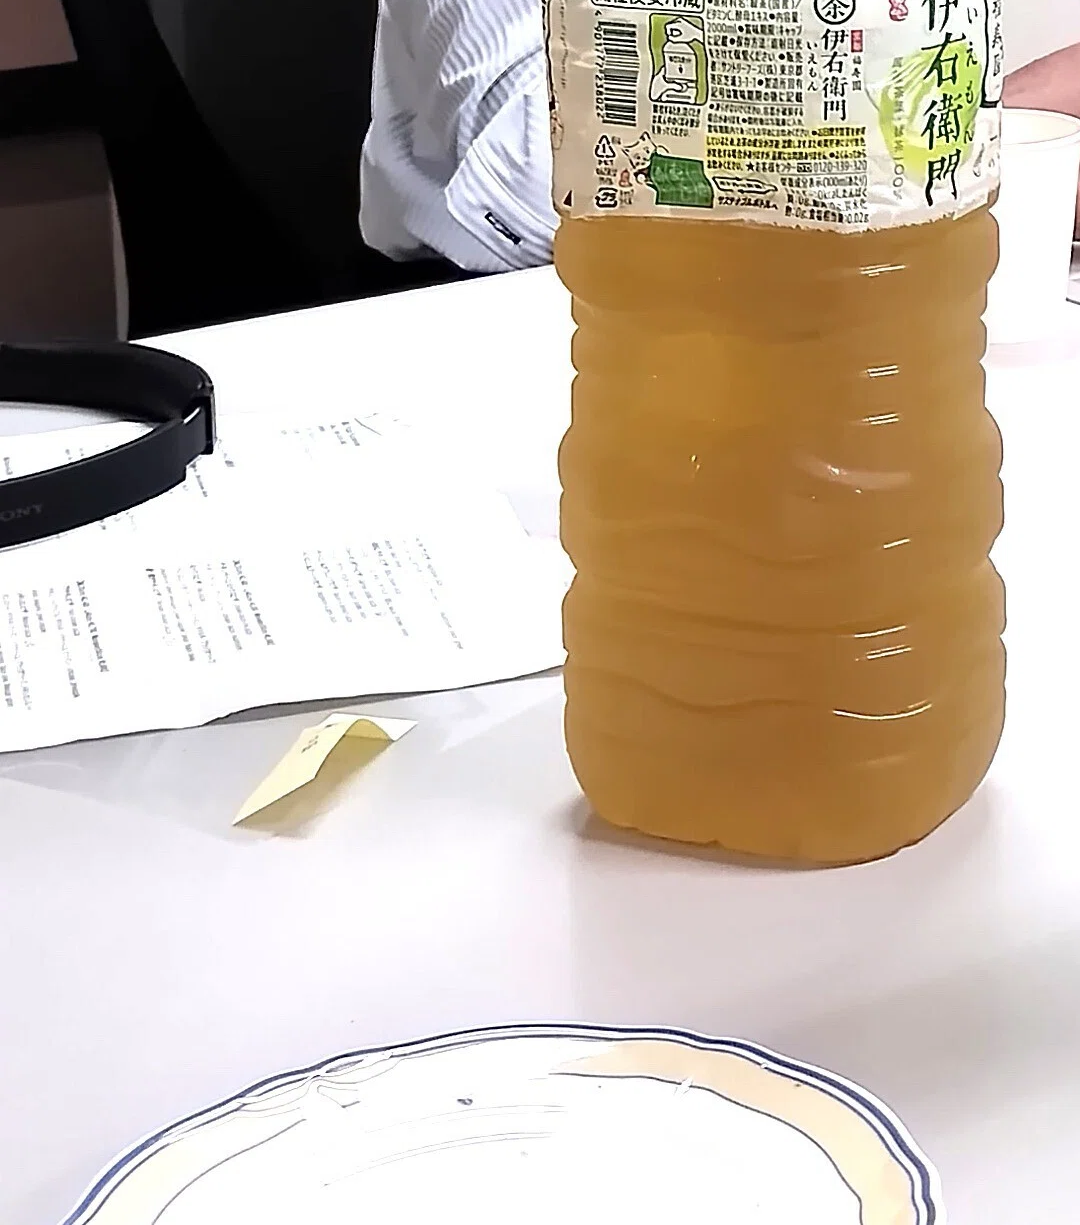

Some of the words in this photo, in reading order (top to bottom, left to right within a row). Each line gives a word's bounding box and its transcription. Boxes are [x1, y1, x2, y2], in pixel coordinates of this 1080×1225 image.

[806, 41, 818, 92] いえもん
[821, 28, 849, 121] 伊右衛門
